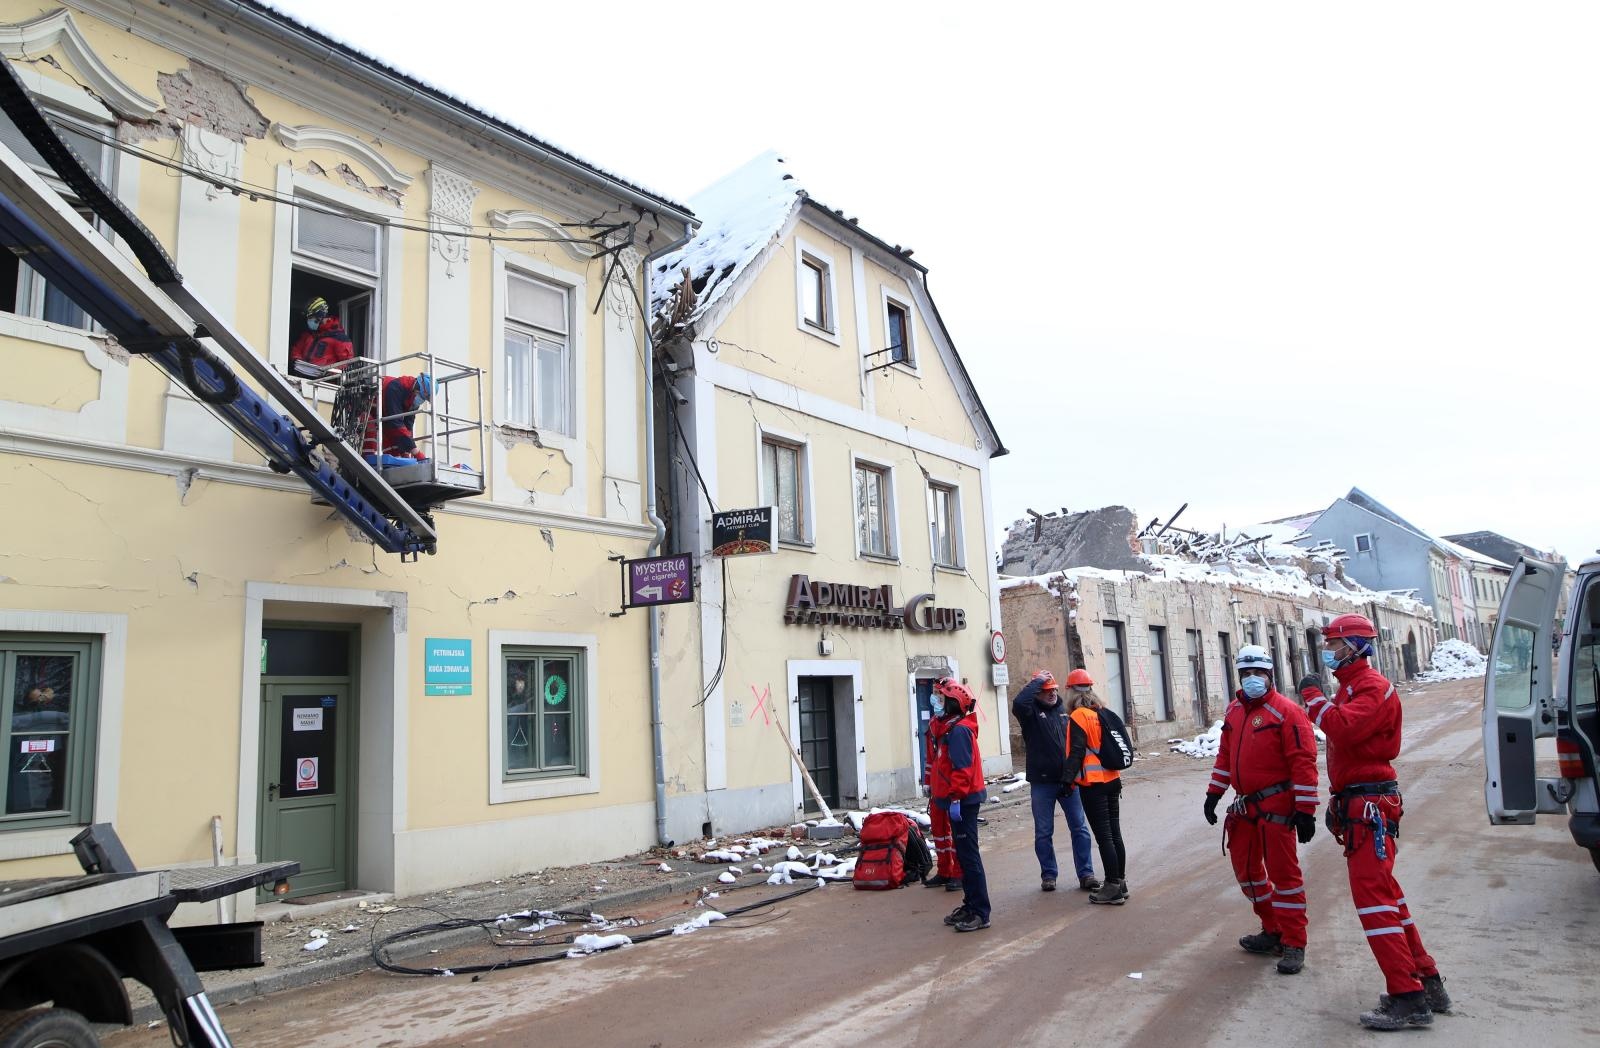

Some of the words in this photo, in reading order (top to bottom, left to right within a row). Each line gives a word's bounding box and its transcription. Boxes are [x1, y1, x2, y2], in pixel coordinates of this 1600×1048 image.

[715, 511, 769, 529] ADMIRAL
[634, 559, 686, 576] MYSTERIA
[786, 573, 905, 617] ADMIRAL
[903, 593, 967, 632] CLUB
[811, 610, 885, 628] AUTOMAT
